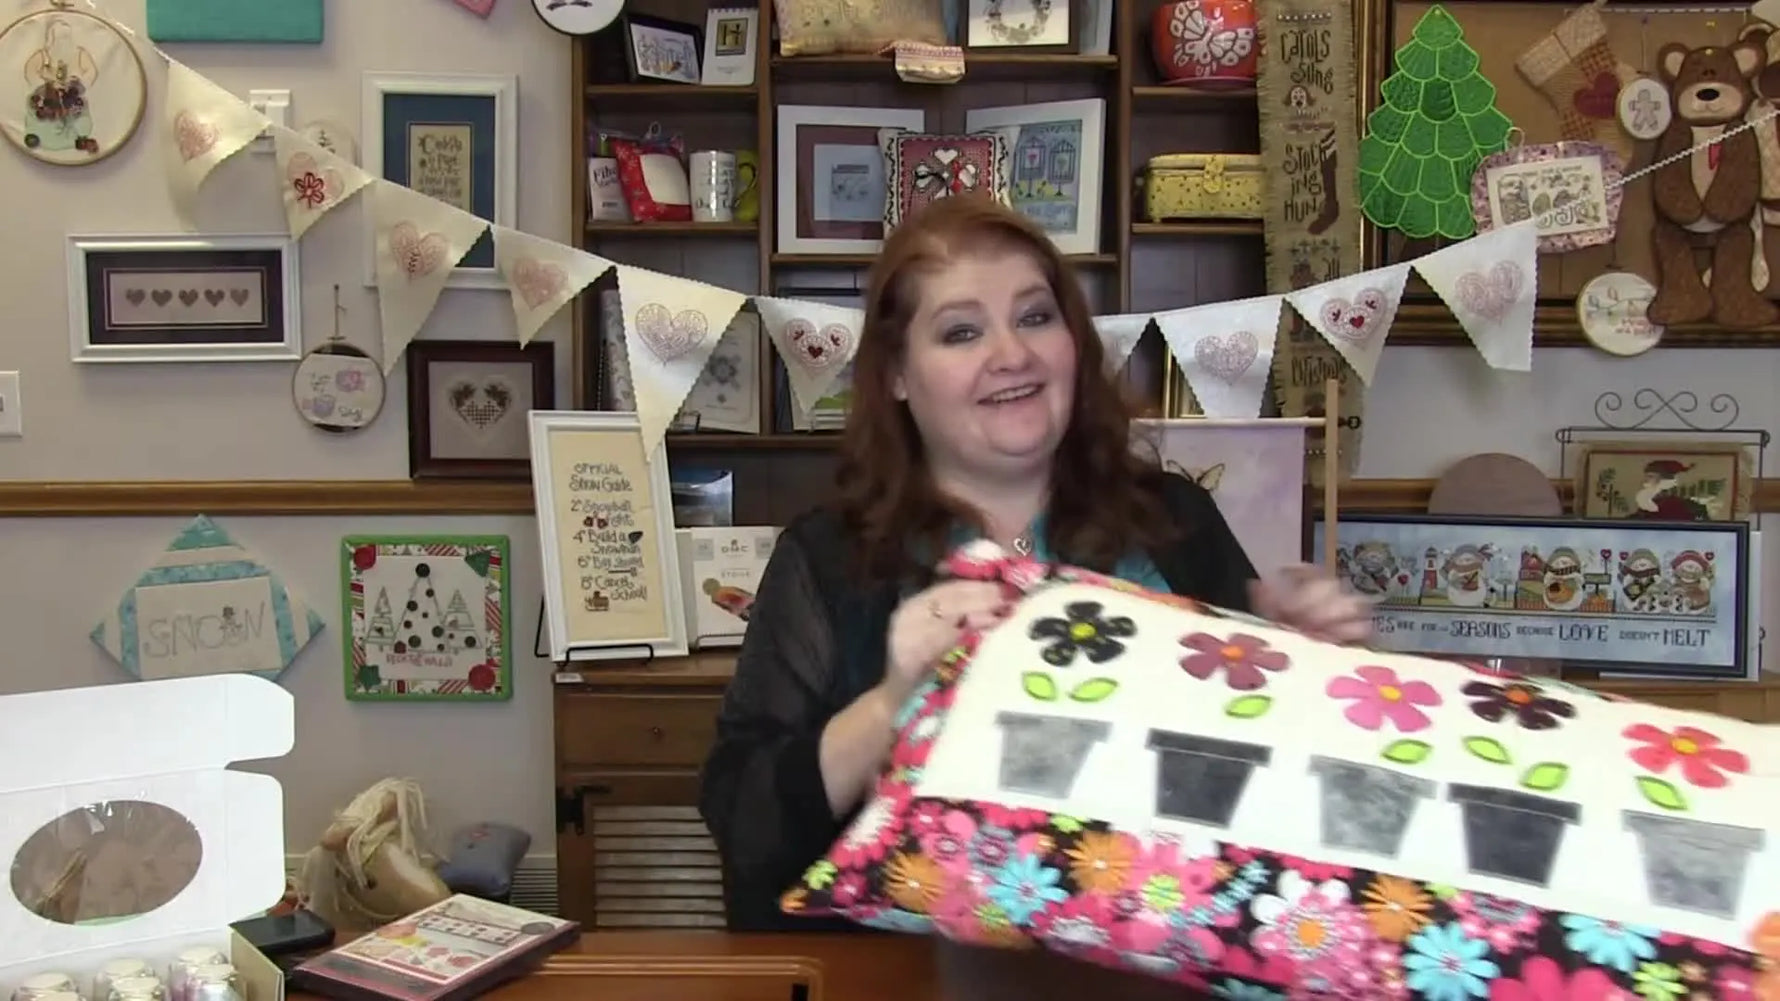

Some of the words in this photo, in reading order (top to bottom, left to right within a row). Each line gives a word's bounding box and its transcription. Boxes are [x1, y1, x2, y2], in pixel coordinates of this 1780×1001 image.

[1450, 619, 1511, 639] SEASONS
[1559, 623, 1608, 642] LOVE
[1663, 628, 1711, 646] MELT
